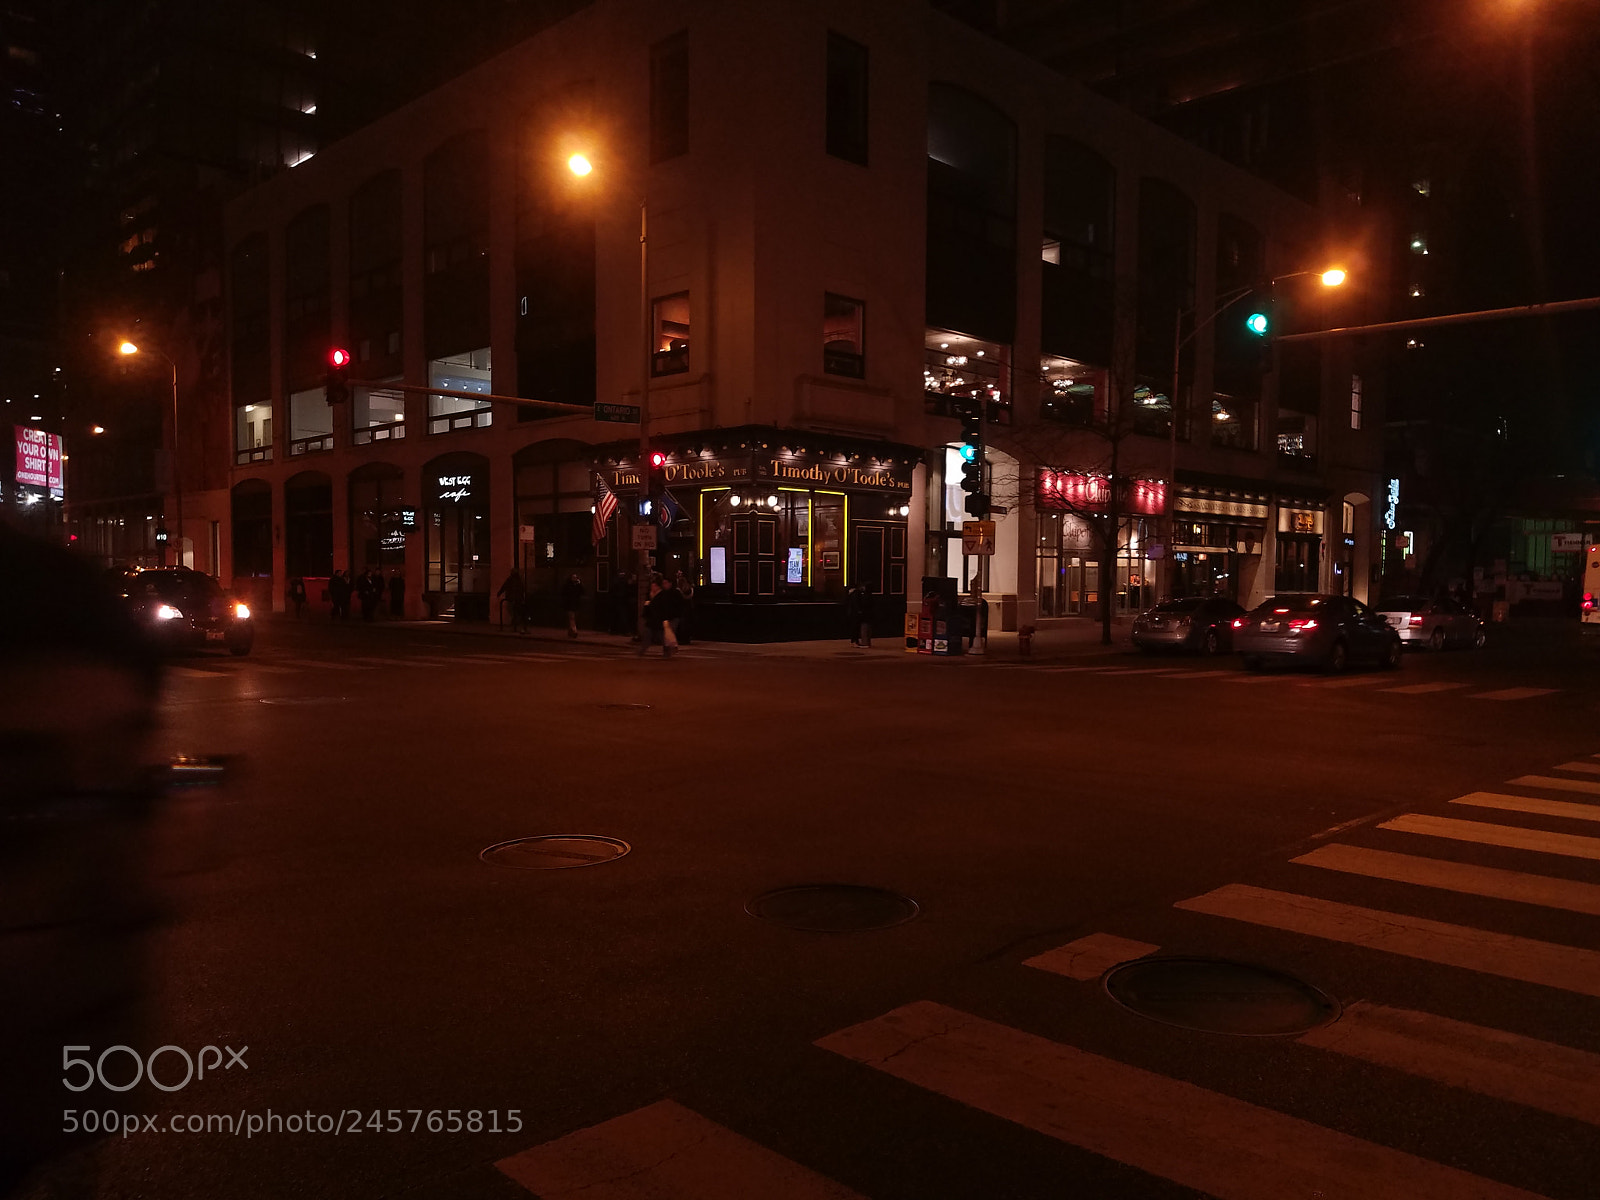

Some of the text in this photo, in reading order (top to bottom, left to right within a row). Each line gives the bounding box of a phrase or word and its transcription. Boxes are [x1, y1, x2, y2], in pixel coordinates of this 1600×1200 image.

[23, 428, 53, 446] CREATE
[17, 440, 59, 461] YOUR OWN
[664, 462, 725, 481] O'Toole's
[770, 459, 831, 484] Timothy
[835, 467, 895, 488] O'Toole's
[439, 476, 457, 487] WEST
